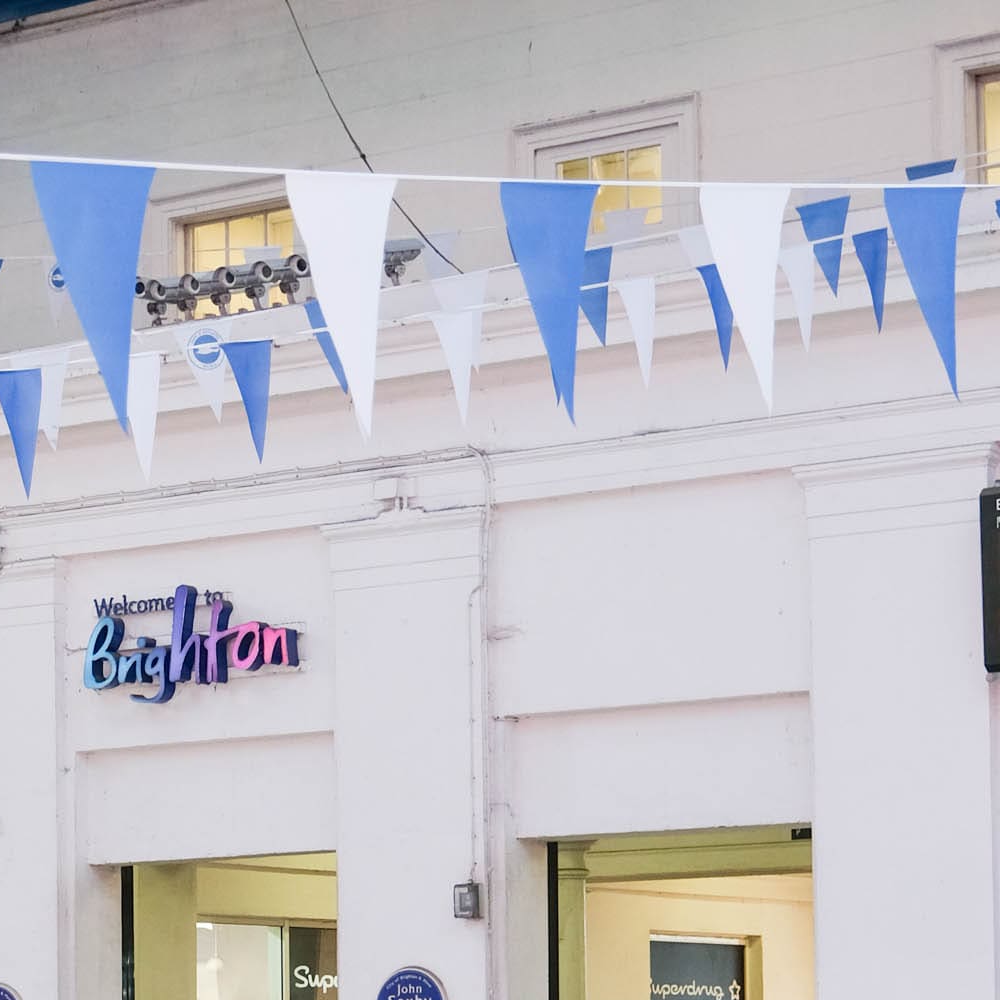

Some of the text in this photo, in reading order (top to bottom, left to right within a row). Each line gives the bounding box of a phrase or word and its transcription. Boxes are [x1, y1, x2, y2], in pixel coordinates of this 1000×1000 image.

[93, 595, 174, 618] Welcome
[83, 584, 299, 704] Brighton
[396, 983, 422, 997] John
